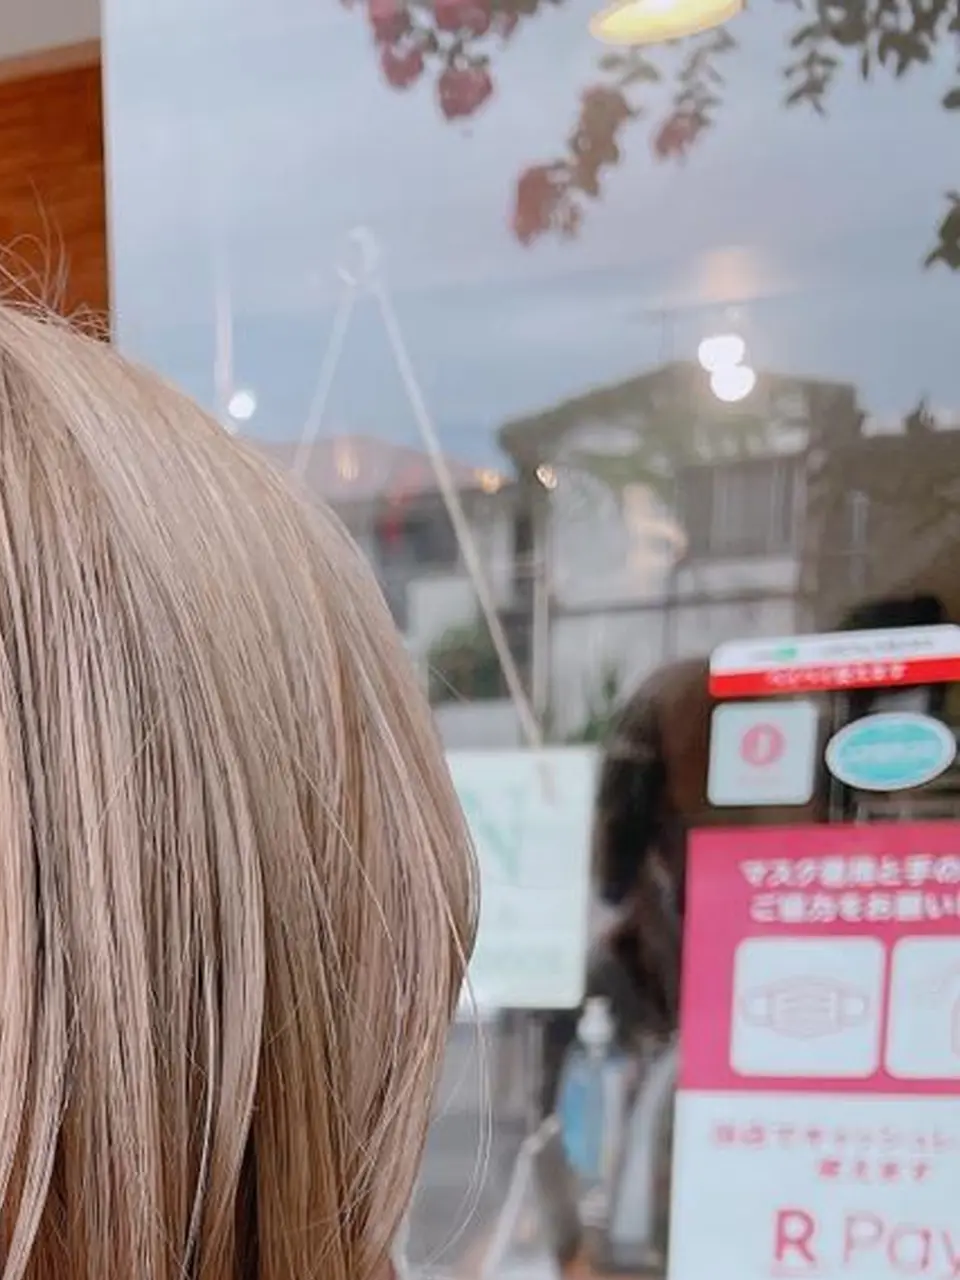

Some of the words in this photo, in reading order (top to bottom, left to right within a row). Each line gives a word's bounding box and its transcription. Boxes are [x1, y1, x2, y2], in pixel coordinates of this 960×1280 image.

[749, 890, 960, 923] ご協力をお願い
